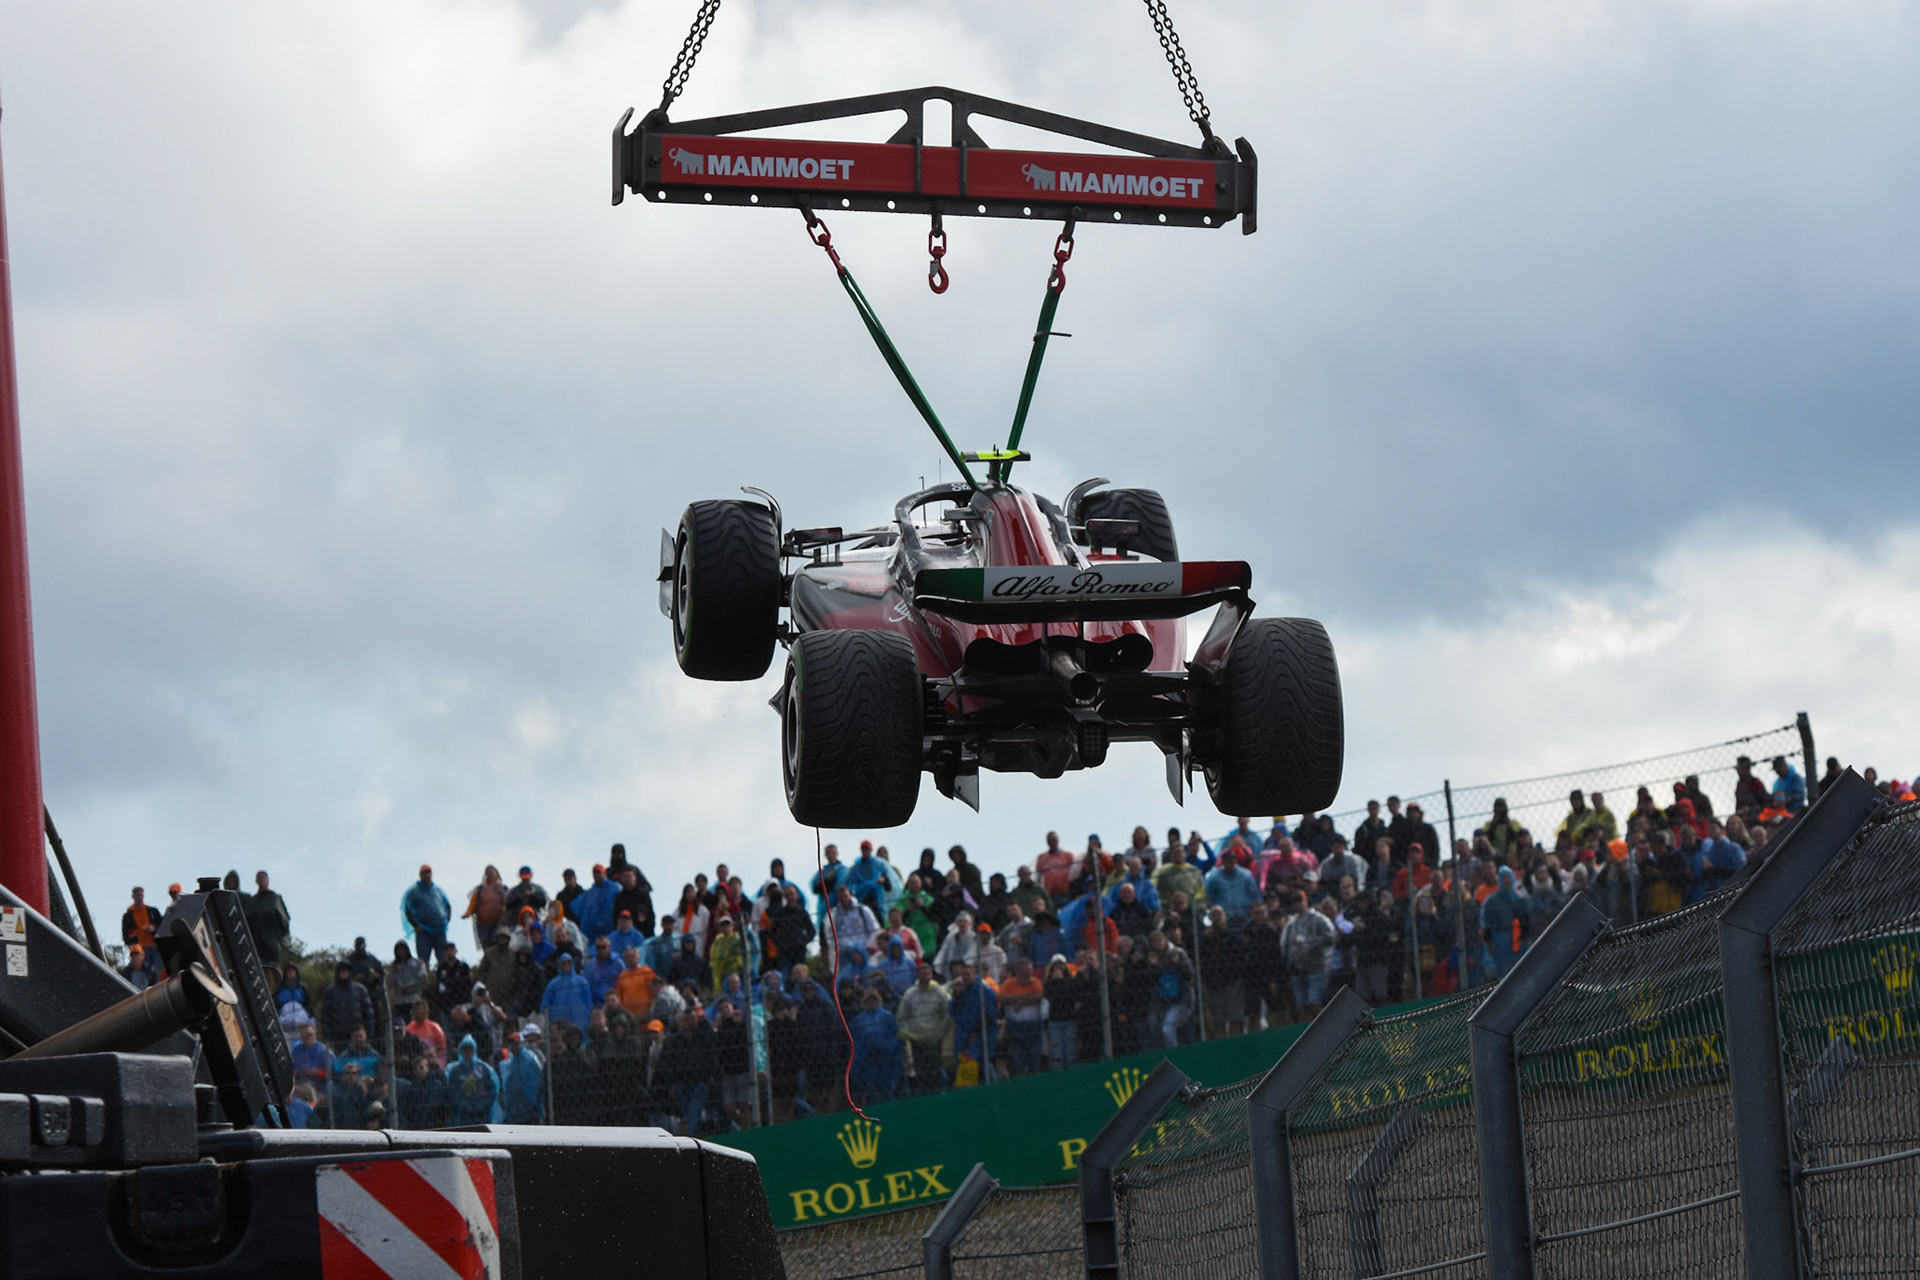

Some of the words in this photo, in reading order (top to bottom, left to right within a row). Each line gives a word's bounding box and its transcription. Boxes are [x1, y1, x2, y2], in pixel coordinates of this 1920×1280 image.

[708, 154, 855, 180] MAMMOET
[1060, 171, 1204, 198] MAMMOET
[991, 576, 1066, 600] Alfa
[1066, 572, 1175, 595] Romeo
[1575, 1034, 1724, 1083] ROLEX
[788, 1164, 951, 1222] ROLEX
